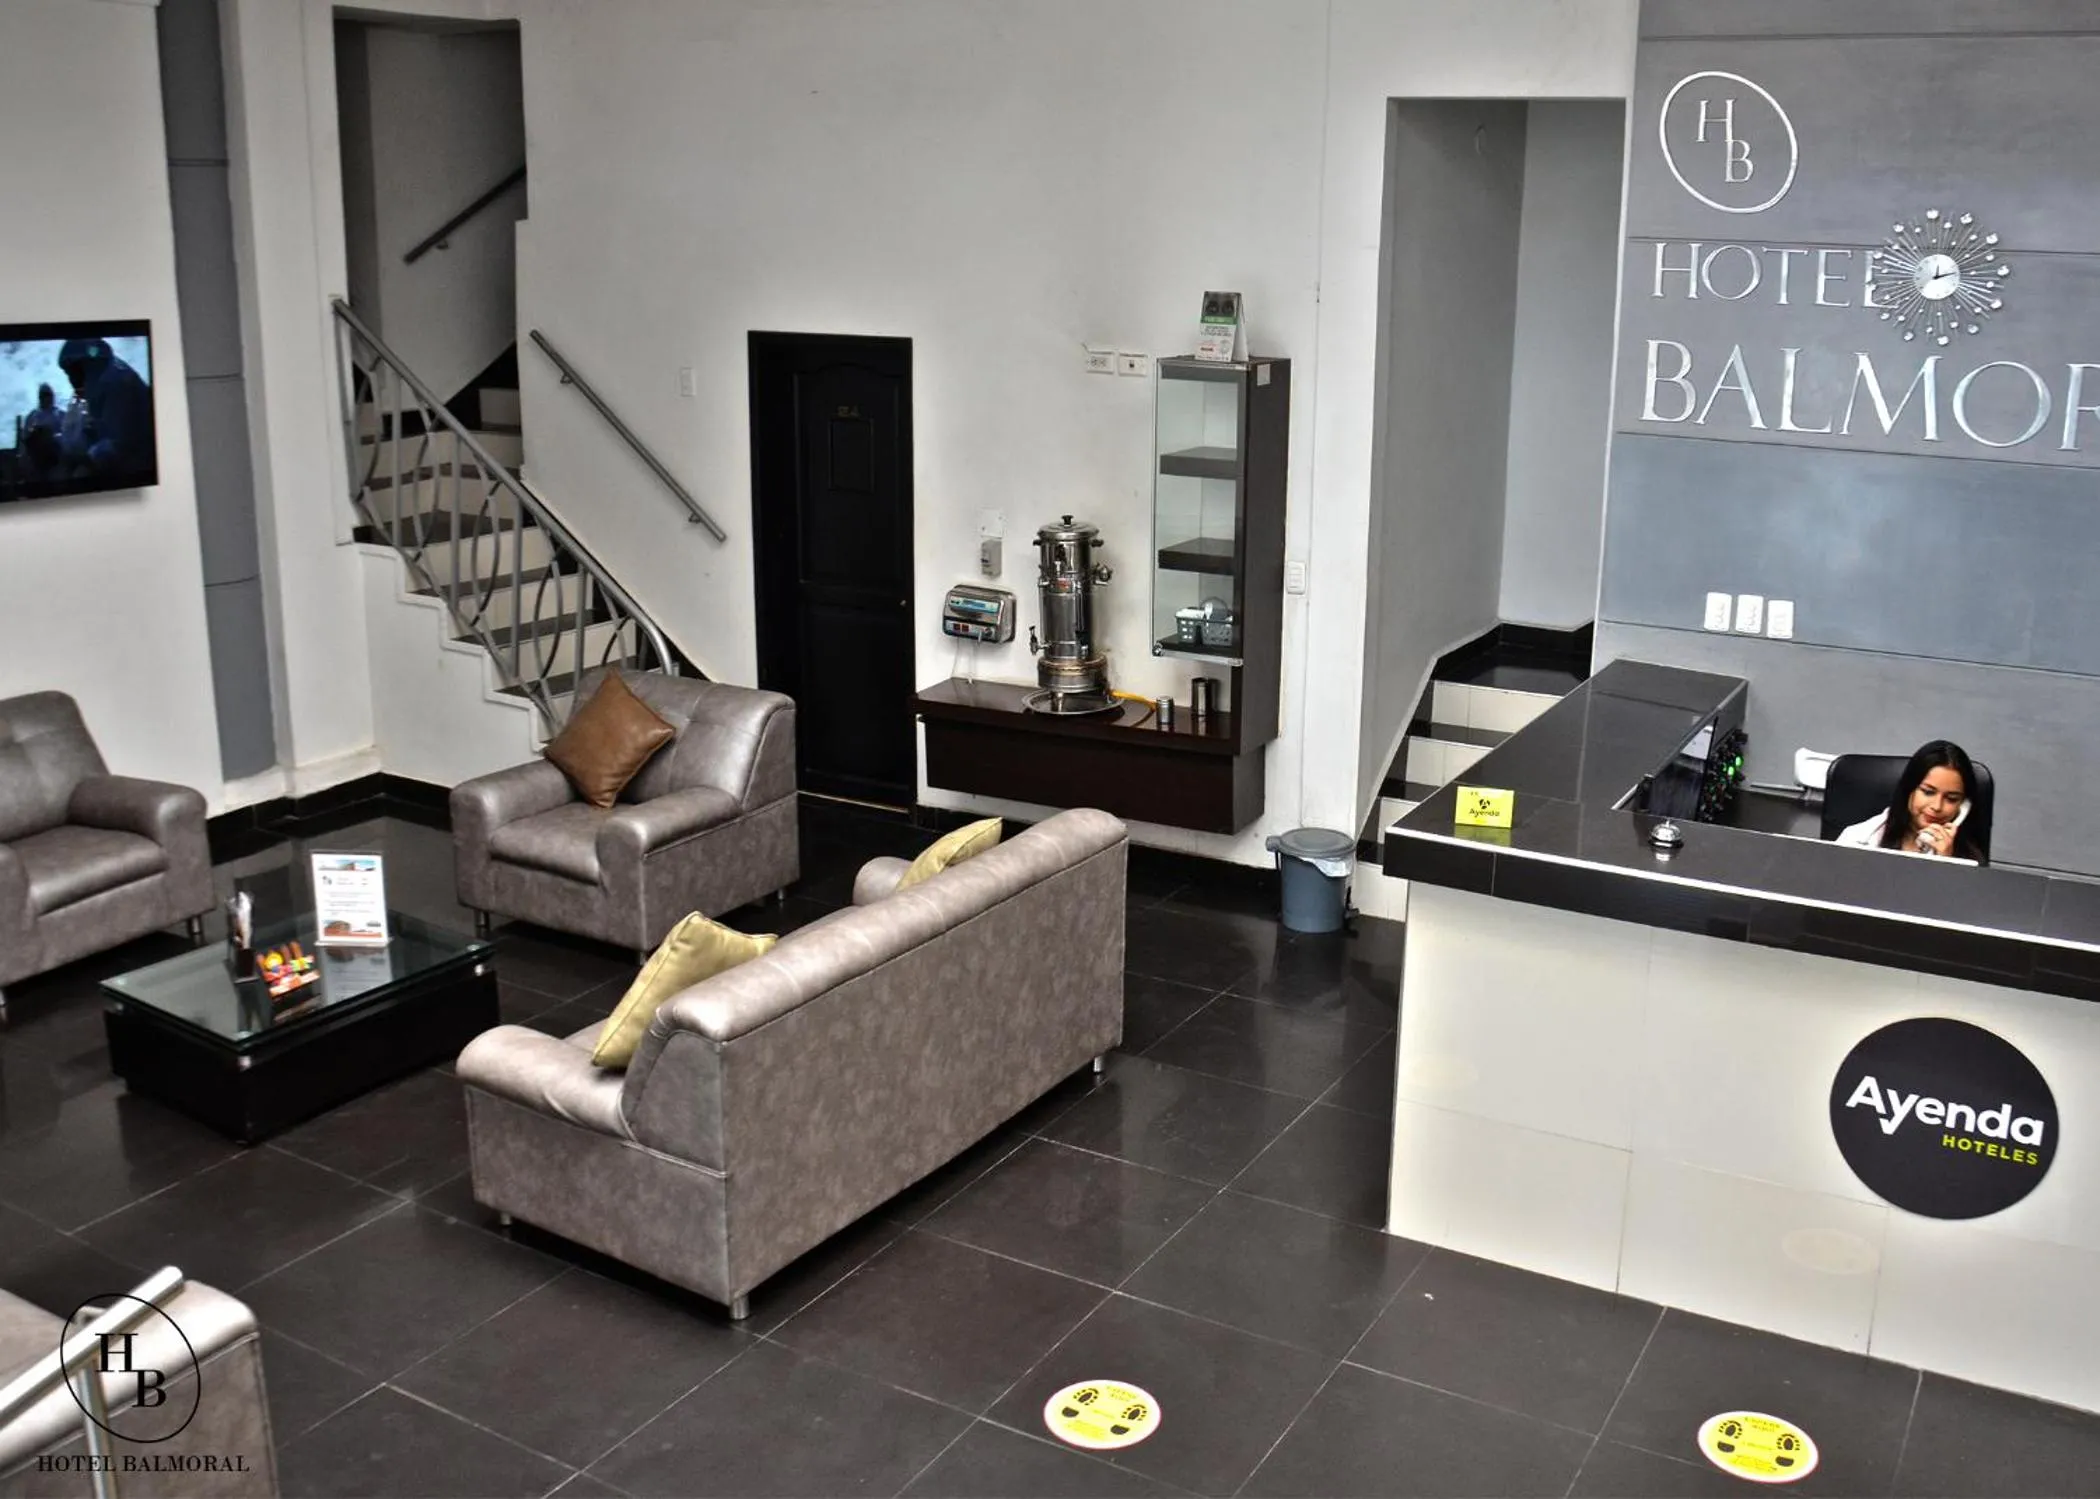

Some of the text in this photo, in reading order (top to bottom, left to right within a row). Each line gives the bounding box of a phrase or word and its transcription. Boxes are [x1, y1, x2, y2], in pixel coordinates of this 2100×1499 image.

[1651, 242, 1898, 308] HOTEL
[1469, 808, 1500, 818] Ayenda
[1846, 1075, 2044, 1147] Ayenda
[1942, 1134, 2039, 1166] HOTELES
